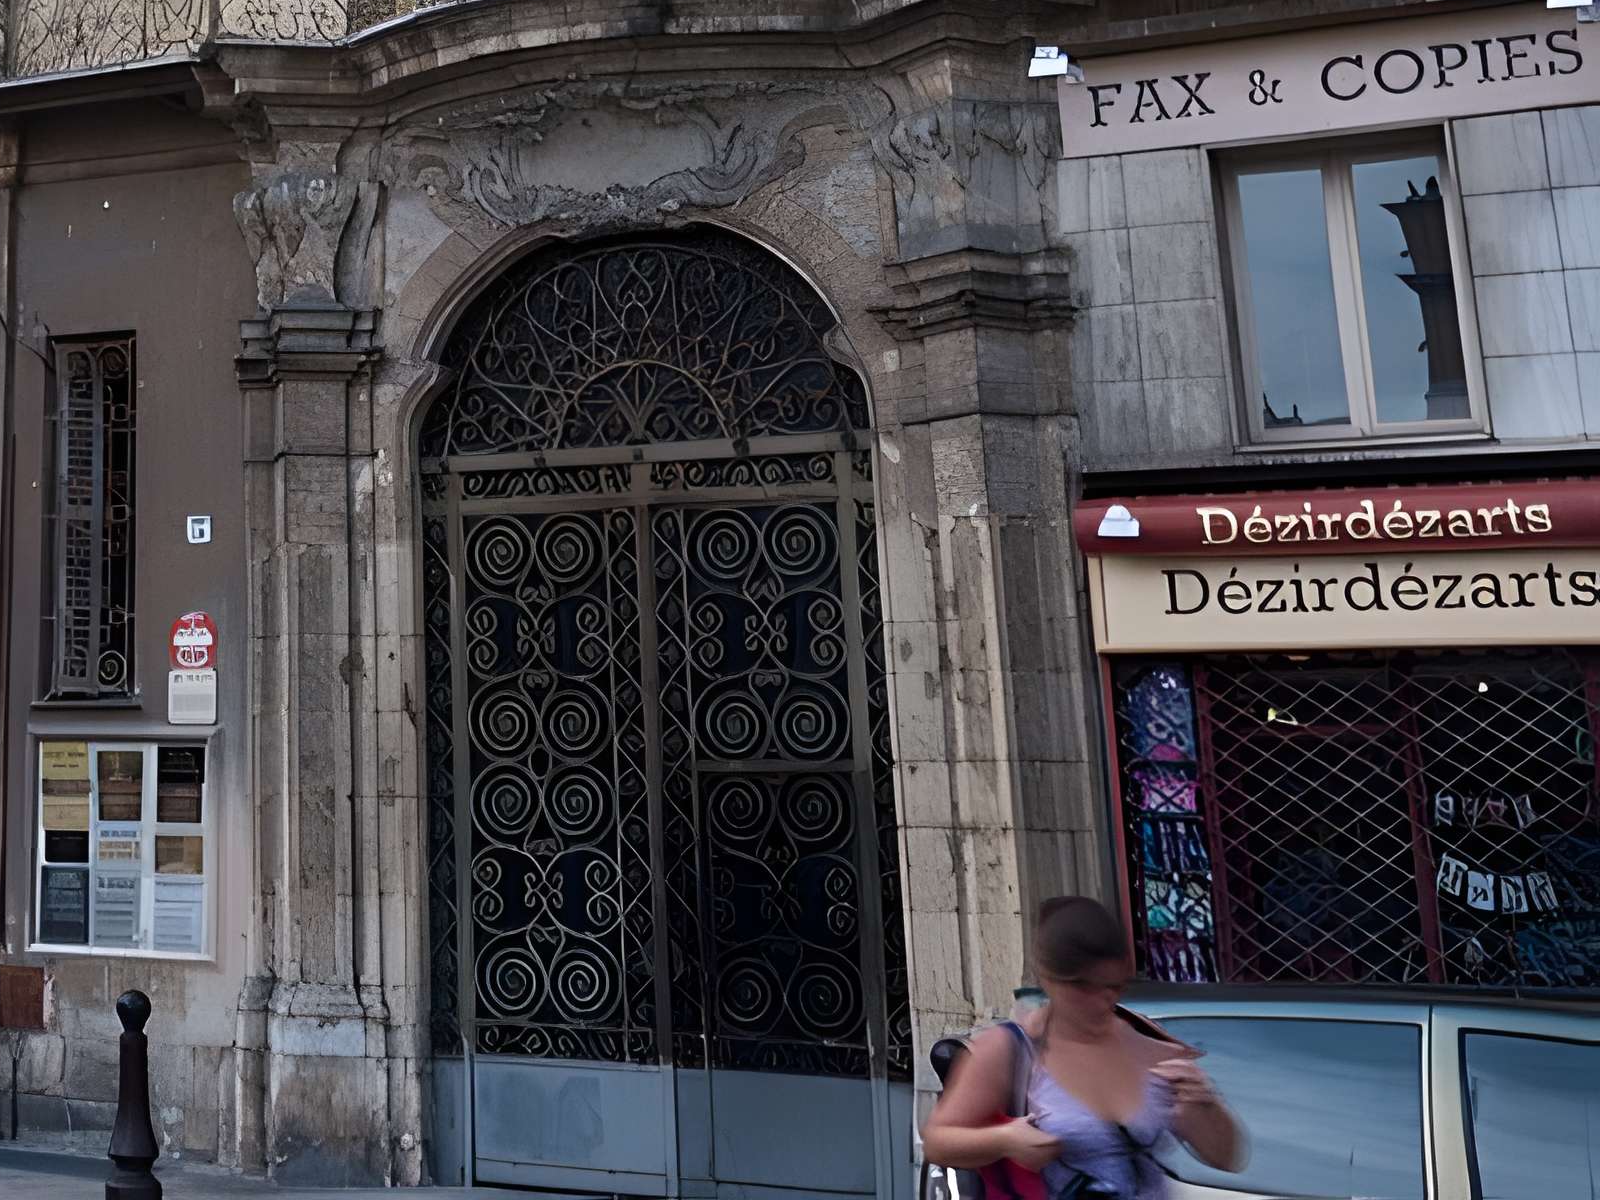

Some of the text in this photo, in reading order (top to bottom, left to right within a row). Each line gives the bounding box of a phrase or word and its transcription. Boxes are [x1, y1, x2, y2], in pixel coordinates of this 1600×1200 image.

[1087, 29, 1584, 128] FAX & COPIES
[1196, 497, 1553, 546] Dézirdézarts
[1161, 562, 1600, 616] Dézirdézarts
